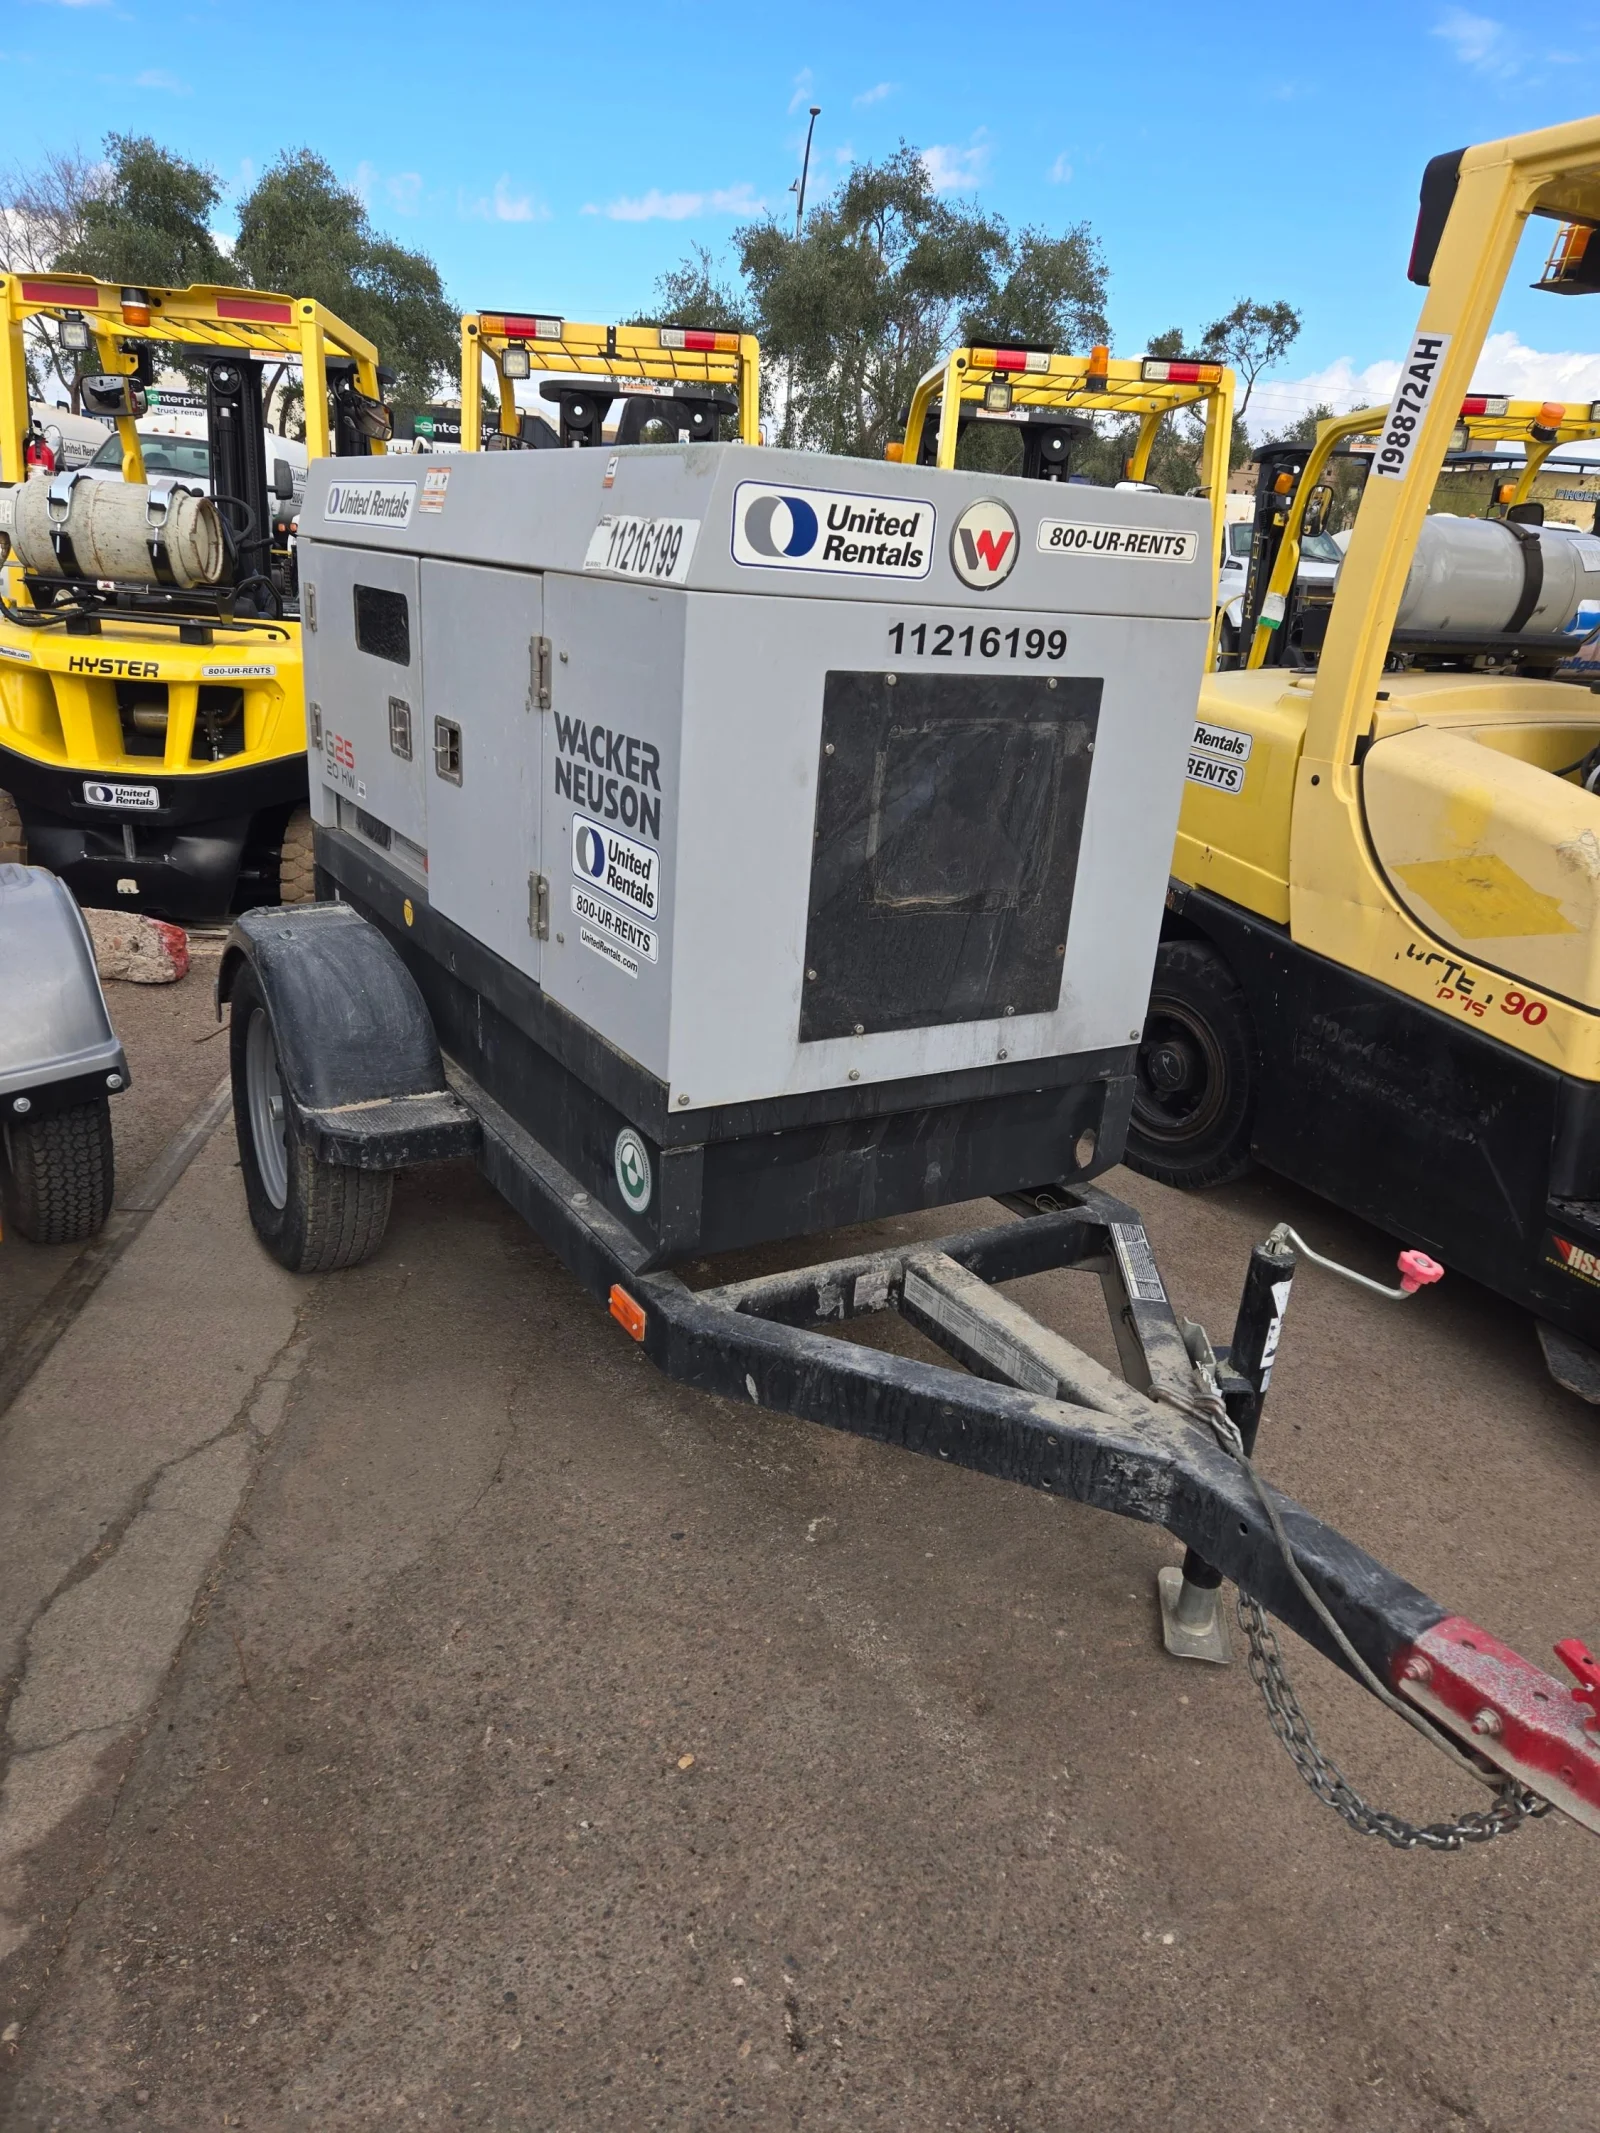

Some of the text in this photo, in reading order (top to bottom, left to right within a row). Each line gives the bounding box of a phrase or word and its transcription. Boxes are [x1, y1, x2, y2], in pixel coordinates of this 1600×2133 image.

[147, 393, 207, 406] enterpri
[157, 407, 205, 417] truck rental
[1377, 338, 1443, 475] 198872AH
[339, 489, 373, 515] United
[369, 490, 409, 518] Rentals
[826, 504, 921, 538] United
[606, 520, 683, 577] 11216199
[822, 534, 924, 568] Rentals
[1049, 527, 1187, 556] 800-UR-RENTS
[888, 622, 1067, 660] 11216199
[69, 656, 159, 678] HYSTER
[208, 667, 271, 675] 800-UR-RENTS
[325, 730, 355, 769] G25
[554, 711, 662, 792] WACKER
[1193, 727, 1245, 754] Rentals
[115, 788, 151, 797] United
[116, 796, 154, 806] Rentals
[555, 756, 661, 841] NEUSON
[608, 839, 652, 881] United
[606, 864, 654, 909] Rentals
[576, 895, 651, 953] 800-UR-RENTS
[581, 929, 638, 973] UnitedRentals.com
[1500, 991, 1548, 1026] 90
